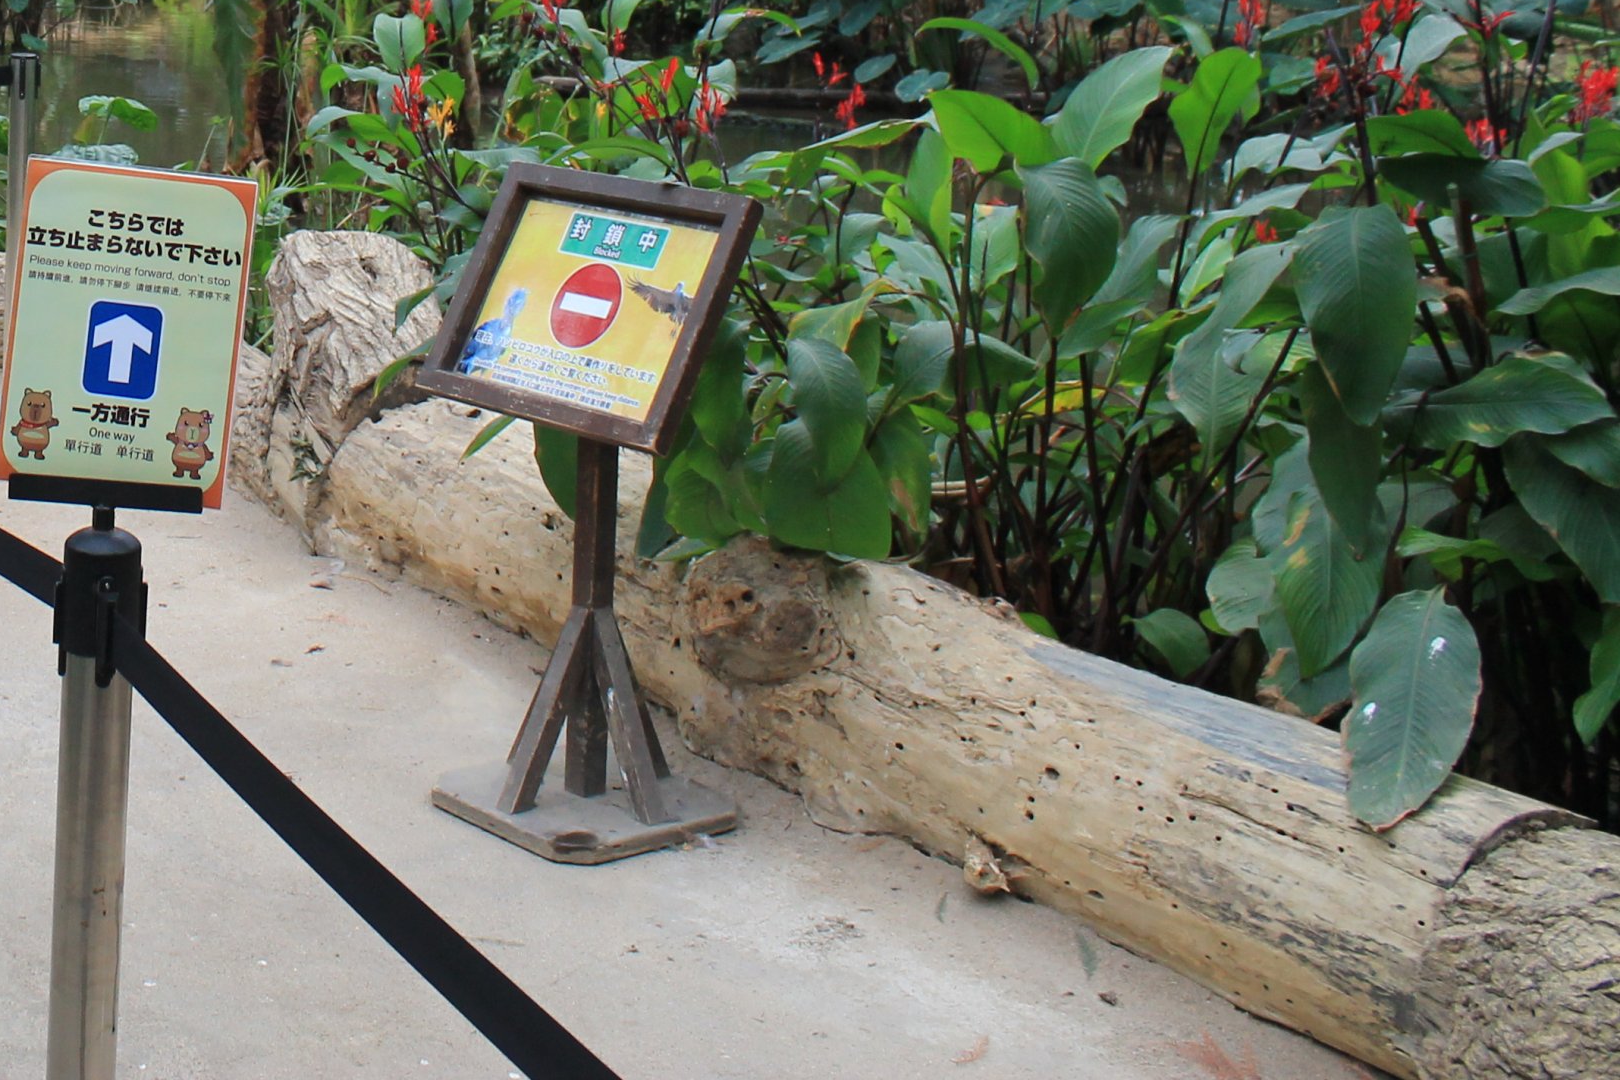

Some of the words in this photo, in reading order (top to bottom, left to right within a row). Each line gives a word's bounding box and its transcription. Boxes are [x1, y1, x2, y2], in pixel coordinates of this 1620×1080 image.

[88, 209, 184, 236] こちらでは
[27, 226, 241, 266] 立ち止まらないで下さい
[593, 245, 621, 259] Blocked
[29, 254, 64, 267] Please
[67, 259, 92, 271] keep
[94, 263, 132, 276] moving
[134, 266, 174, 280] forward,
[178, 272, 204, 284] don't
[207, 276, 231, 287] stop
[72, 403, 150, 428] 一方通行
[89, 427, 111, 440] One
[113, 431, 135, 445] way
[64, 438, 102, 456] 單行道
[116, 444, 154, 462] 单行道
